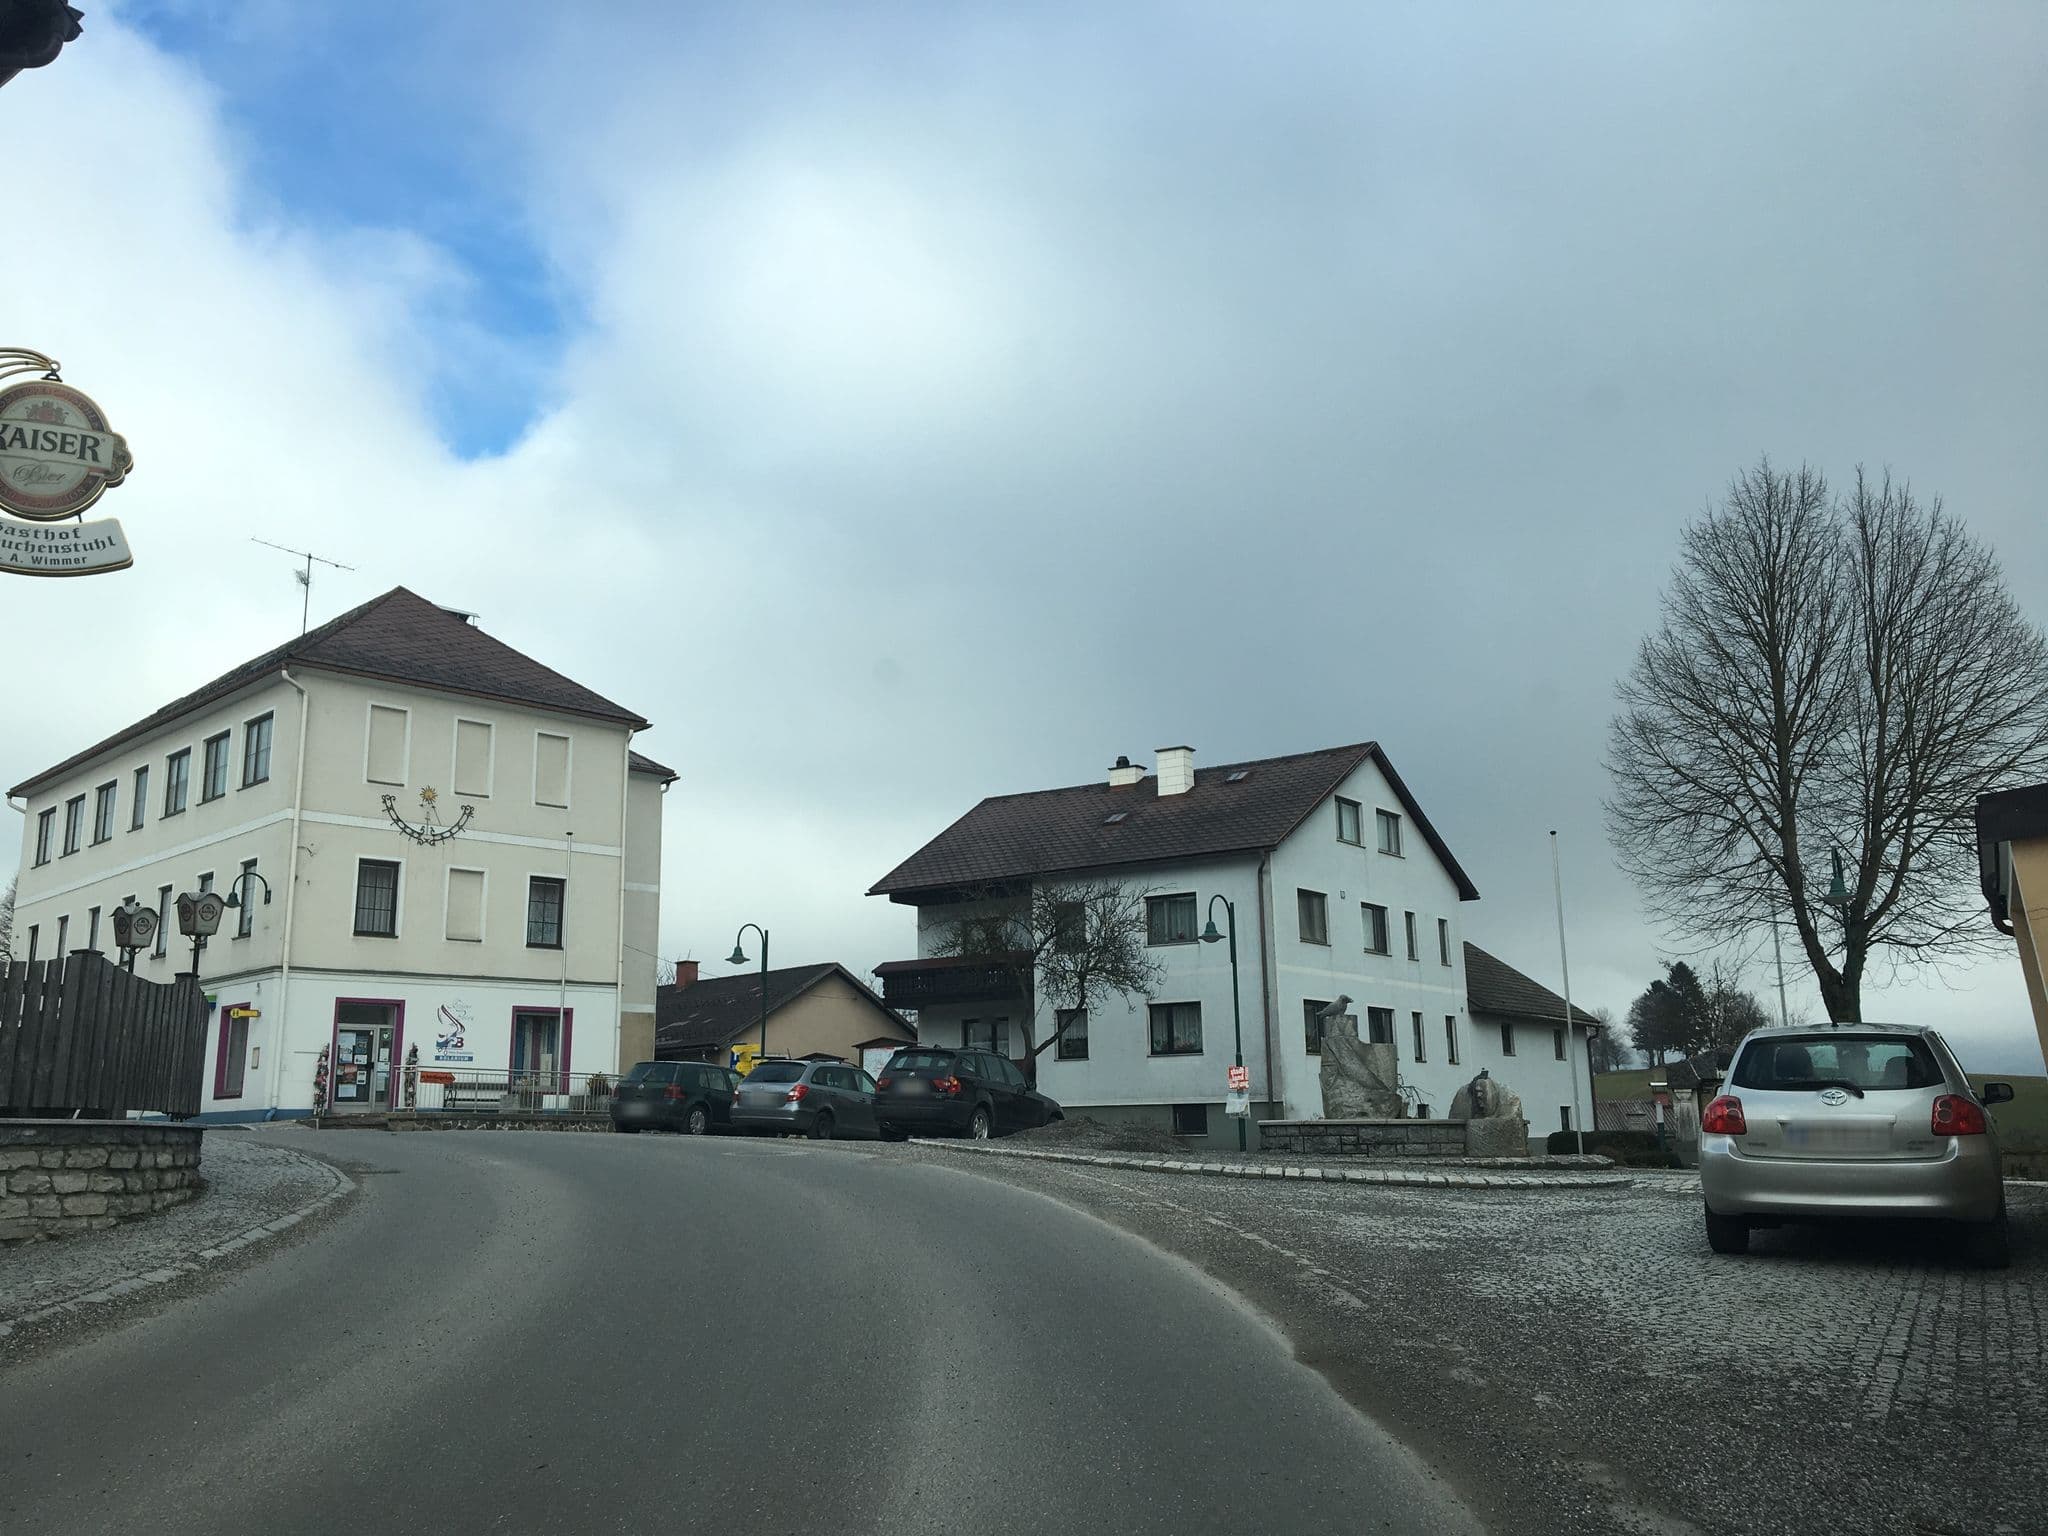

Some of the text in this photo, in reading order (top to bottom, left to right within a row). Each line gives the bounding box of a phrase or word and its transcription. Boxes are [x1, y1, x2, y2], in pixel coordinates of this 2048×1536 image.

[1, 536, 116, 553] uchenstuhl
[10, 553, 88, 566] A. Wimmer
